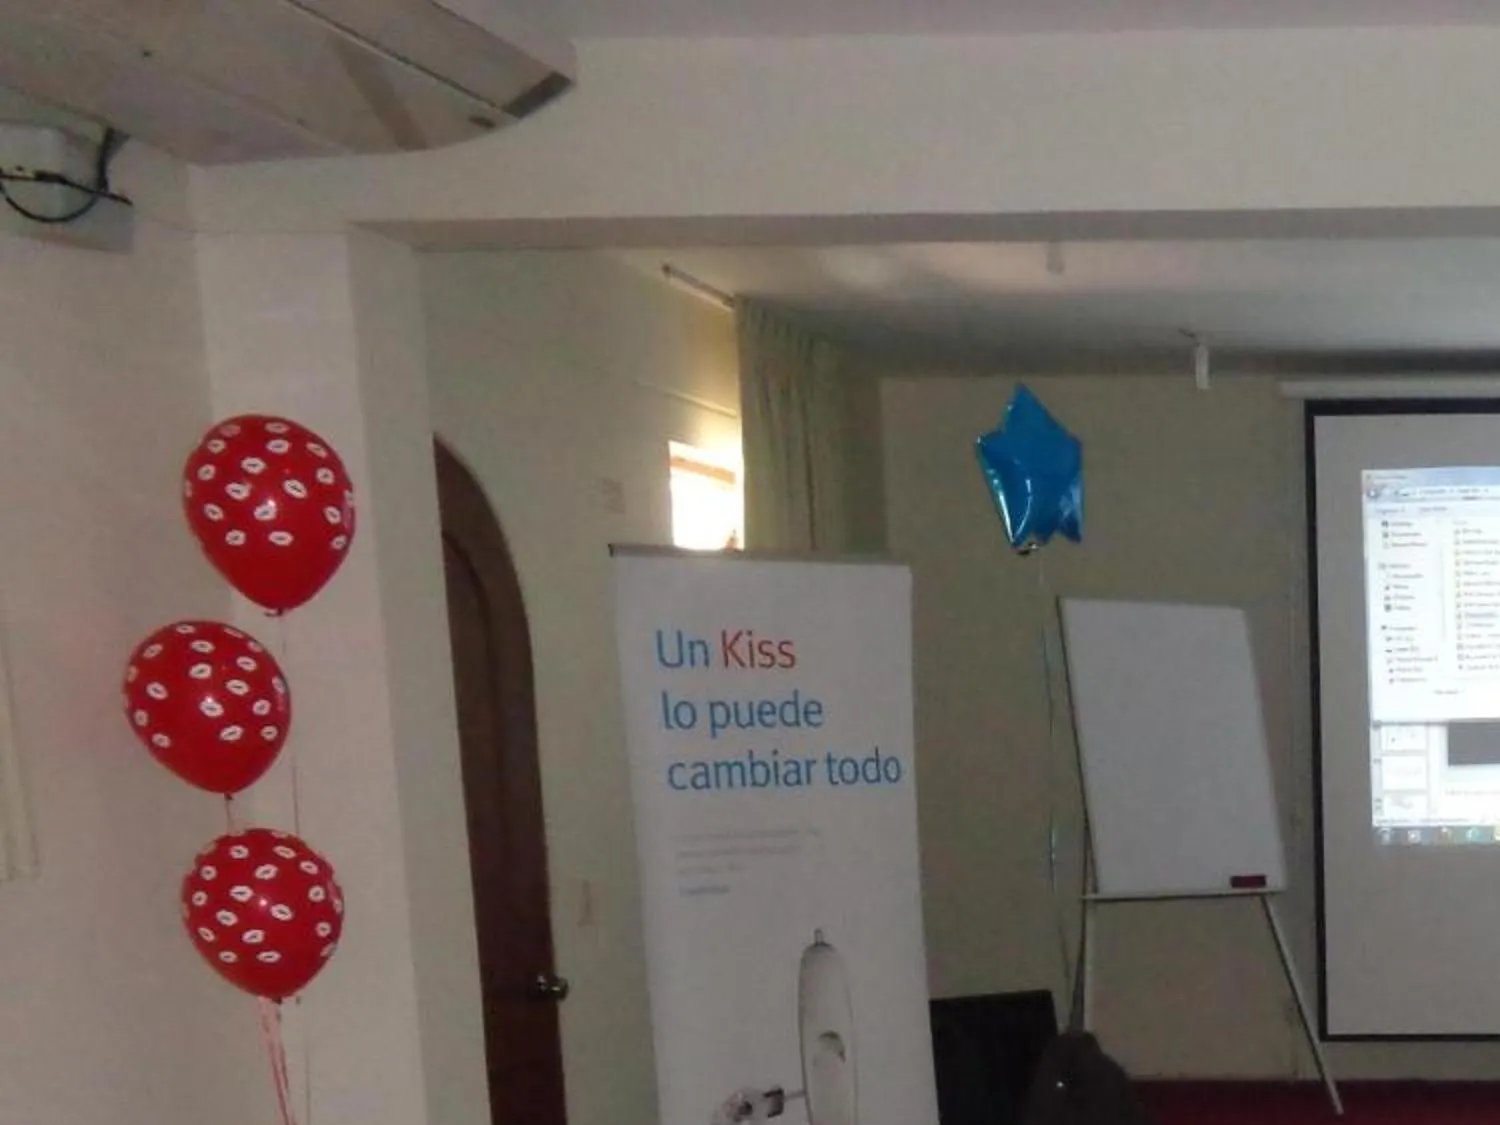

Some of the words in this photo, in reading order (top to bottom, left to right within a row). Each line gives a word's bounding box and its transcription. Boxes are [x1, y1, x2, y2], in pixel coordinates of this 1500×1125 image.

[655, 629, 710, 669] Un
[720, 629, 797, 669] Kiss
[661, 690, 697, 730] lo
[708, 689, 824, 739] puede
[667, 749, 817, 791] cambiar
[826, 747, 902, 786] todo
